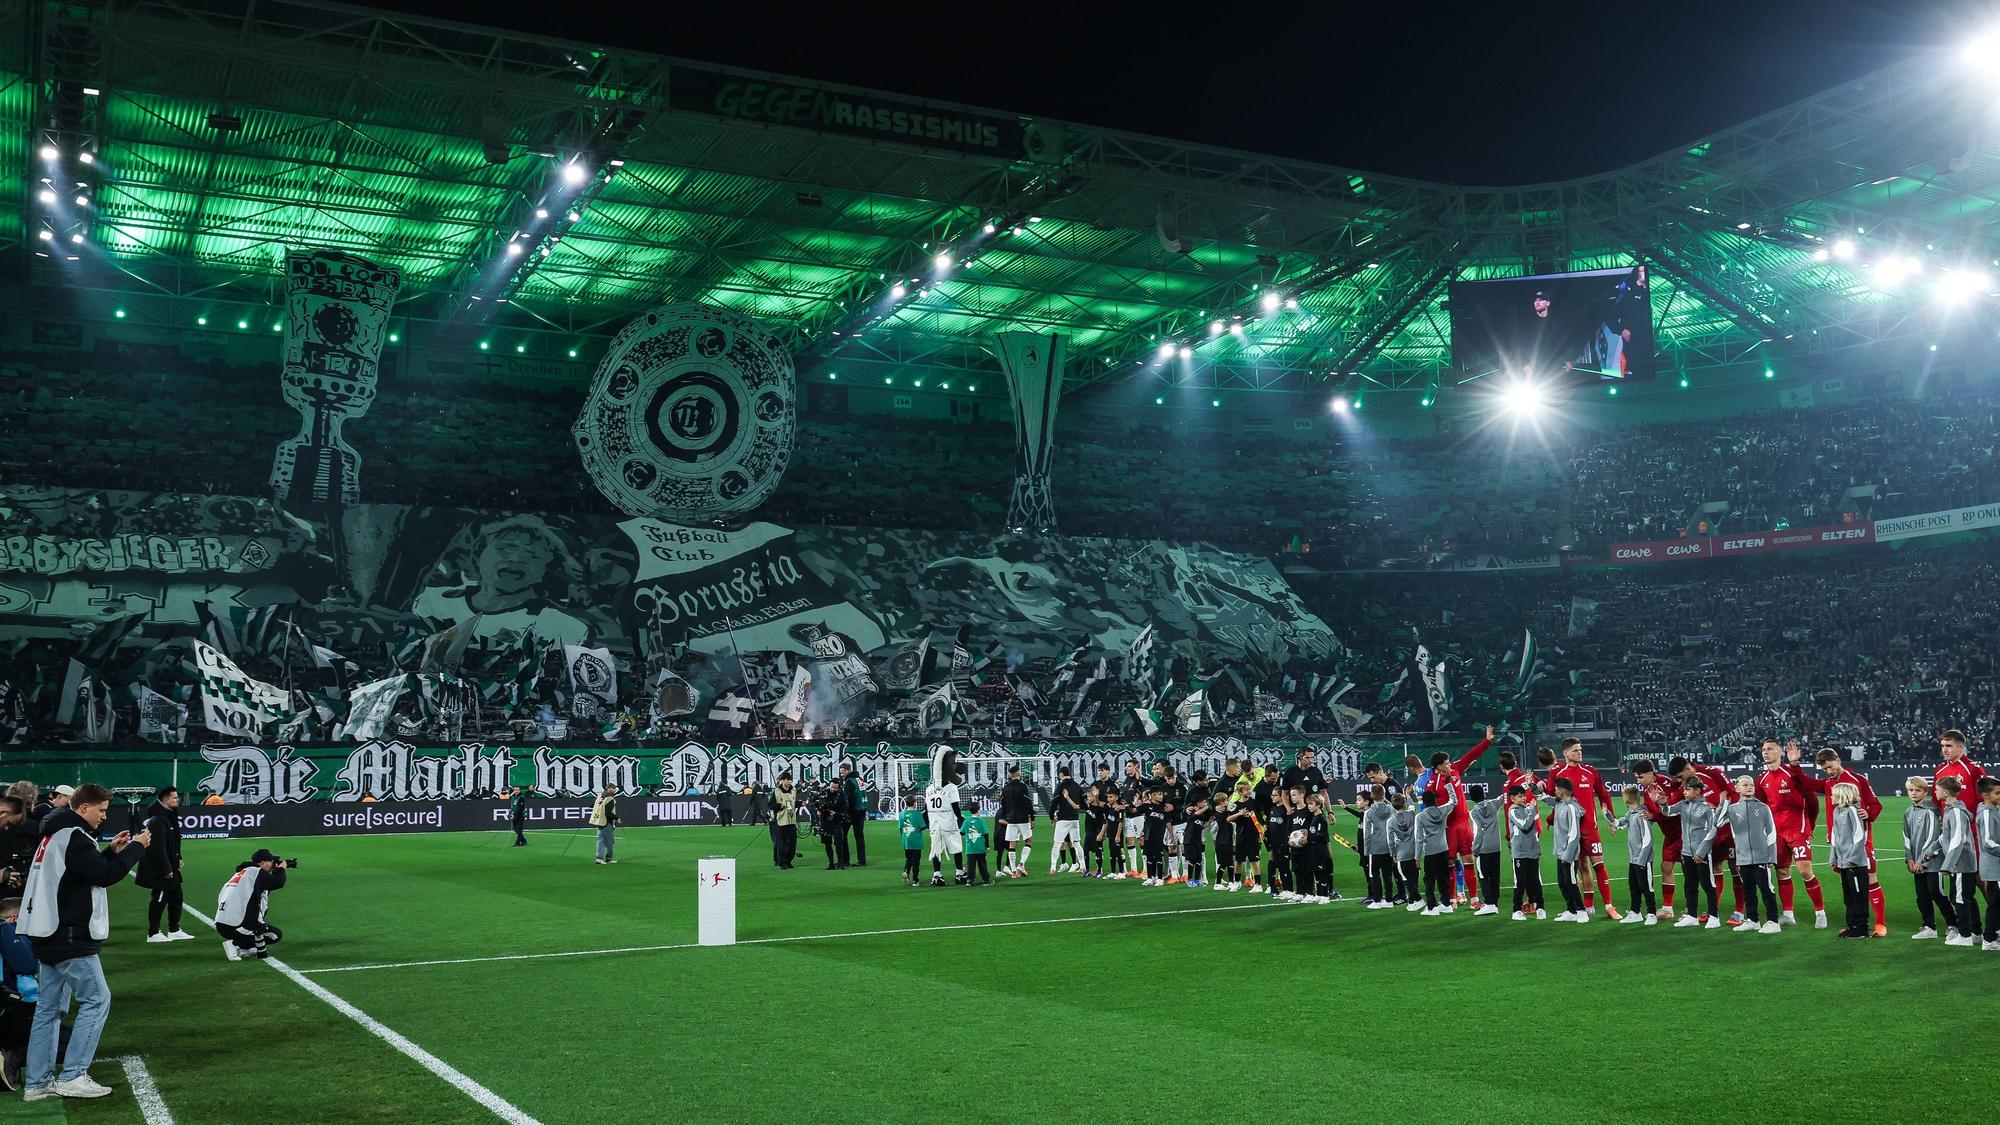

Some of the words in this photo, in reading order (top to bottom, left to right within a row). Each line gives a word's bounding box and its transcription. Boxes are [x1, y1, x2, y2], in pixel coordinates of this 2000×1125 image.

[835, 101, 999, 148] RASSISMUS
[1876, 519, 1927, 536] RHEINISCHE
[1928, 514, 1951, 527] POST
[1962, 511, 1976, 522] RP
[1822, 528, 1865, 541] ELTEN
[1616, 548, 1652, 559] cewe
[1667, 543, 1702, 555] cewe
[1723, 538, 1765, 550] ELTEN
[651, 545, 715, 561] Club
[1623, 752, 1665, 761] NORDHARZ
[197, 745, 319, 804] Die
[333, 740, 518, 802] Macht
[533, 745, 642, 798] vom
[930, 797, 942, 808] 10
[323, 805, 443, 830] sure[secure]
[647, 801, 701, 821] PUMA
[1292, 816, 1307, 826] sky
[1792, 846, 1807, 859] 32
